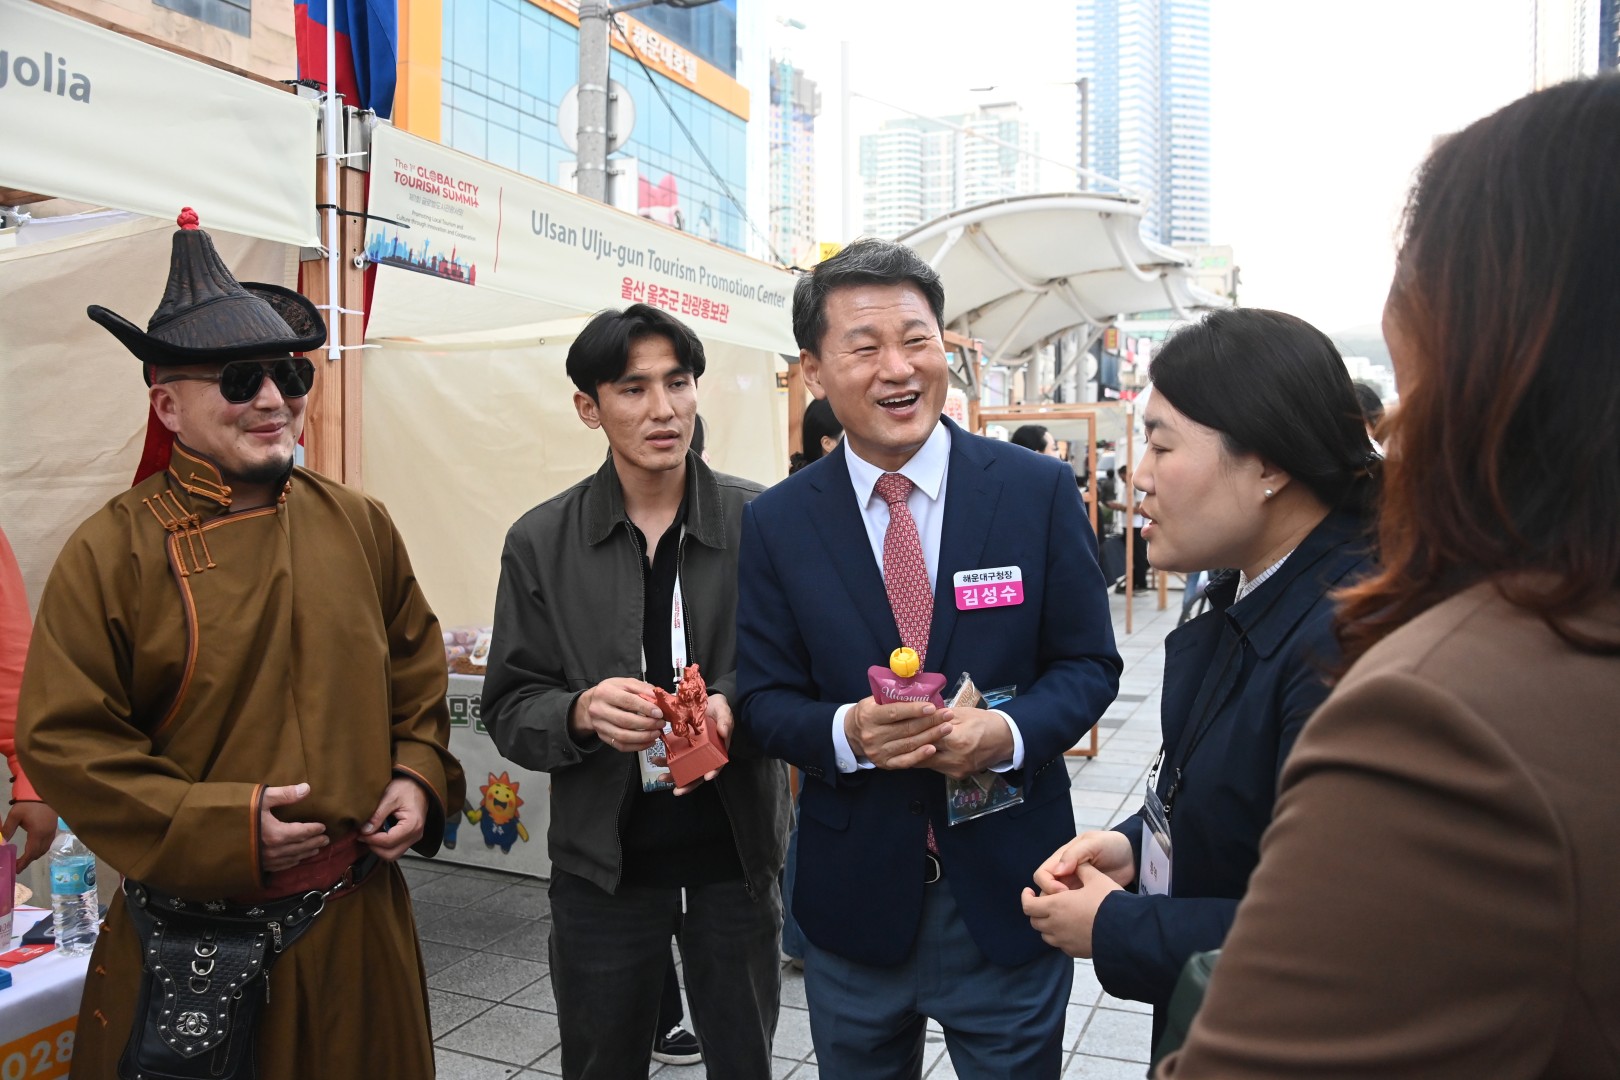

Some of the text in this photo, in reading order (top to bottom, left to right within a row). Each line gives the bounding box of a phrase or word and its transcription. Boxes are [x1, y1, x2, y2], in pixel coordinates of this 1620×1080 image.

[393, 171, 440, 196] TOURISM
[394, 158, 408, 171] The
[417, 166, 456, 189] GLOBAL
[457, 181, 479, 196] CITY
[531, 209, 786, 309] Ulsan Ulju-gun Tourism Promotion Center
[621, 276, 729, 324] 울산 울주군 관광홍보관
[962, 570, 1013, 583] 해운대구청장
[962, 585, 1017, 607] 김성수
